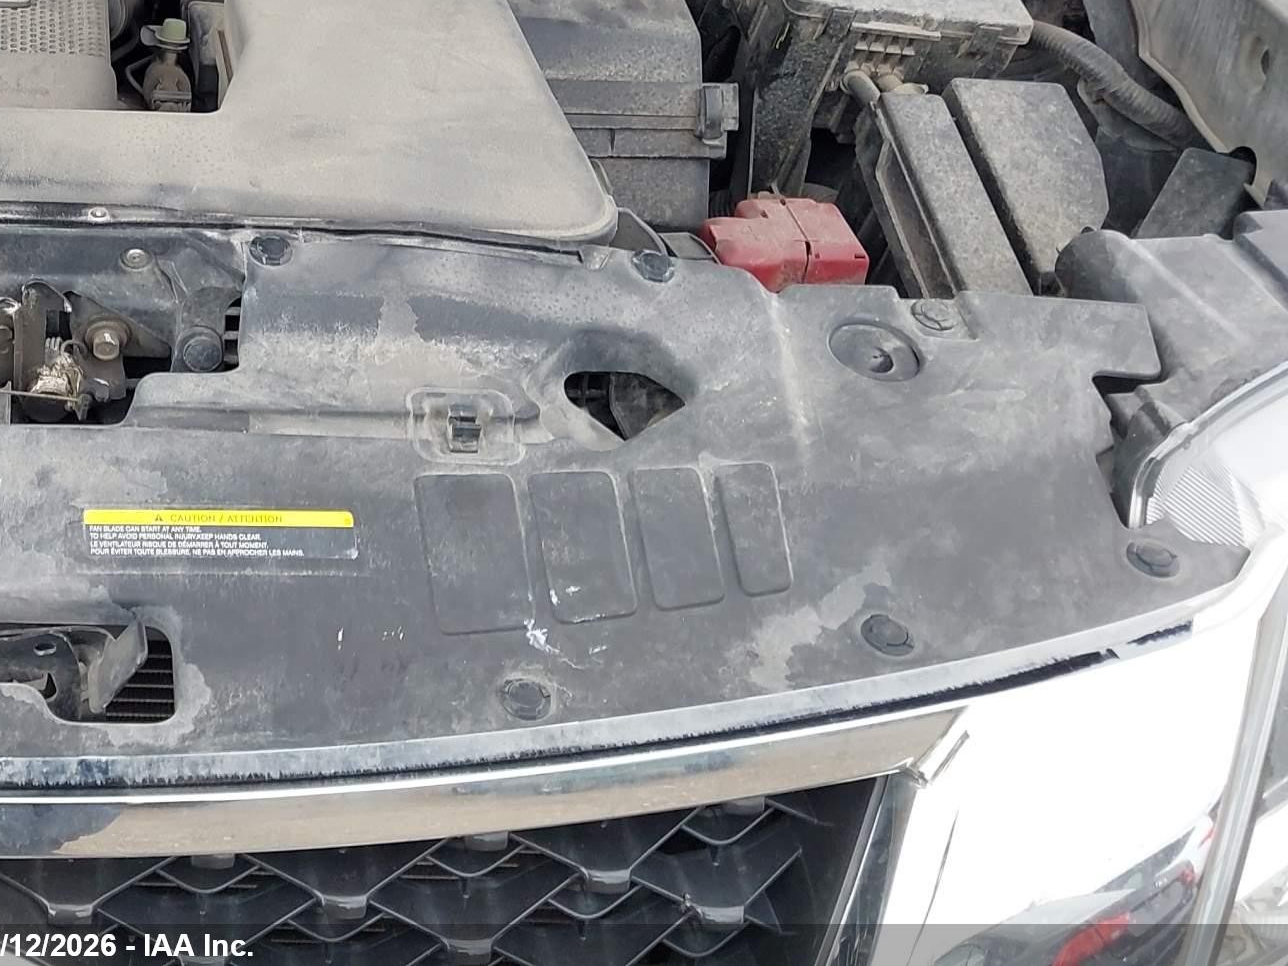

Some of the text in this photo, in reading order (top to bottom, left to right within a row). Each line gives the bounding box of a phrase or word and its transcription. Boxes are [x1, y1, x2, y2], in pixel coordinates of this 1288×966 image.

[170, 514, 283, 523] CAUTION / ATTENTION
[100, 540, 141, 548] VENTILATEUR
